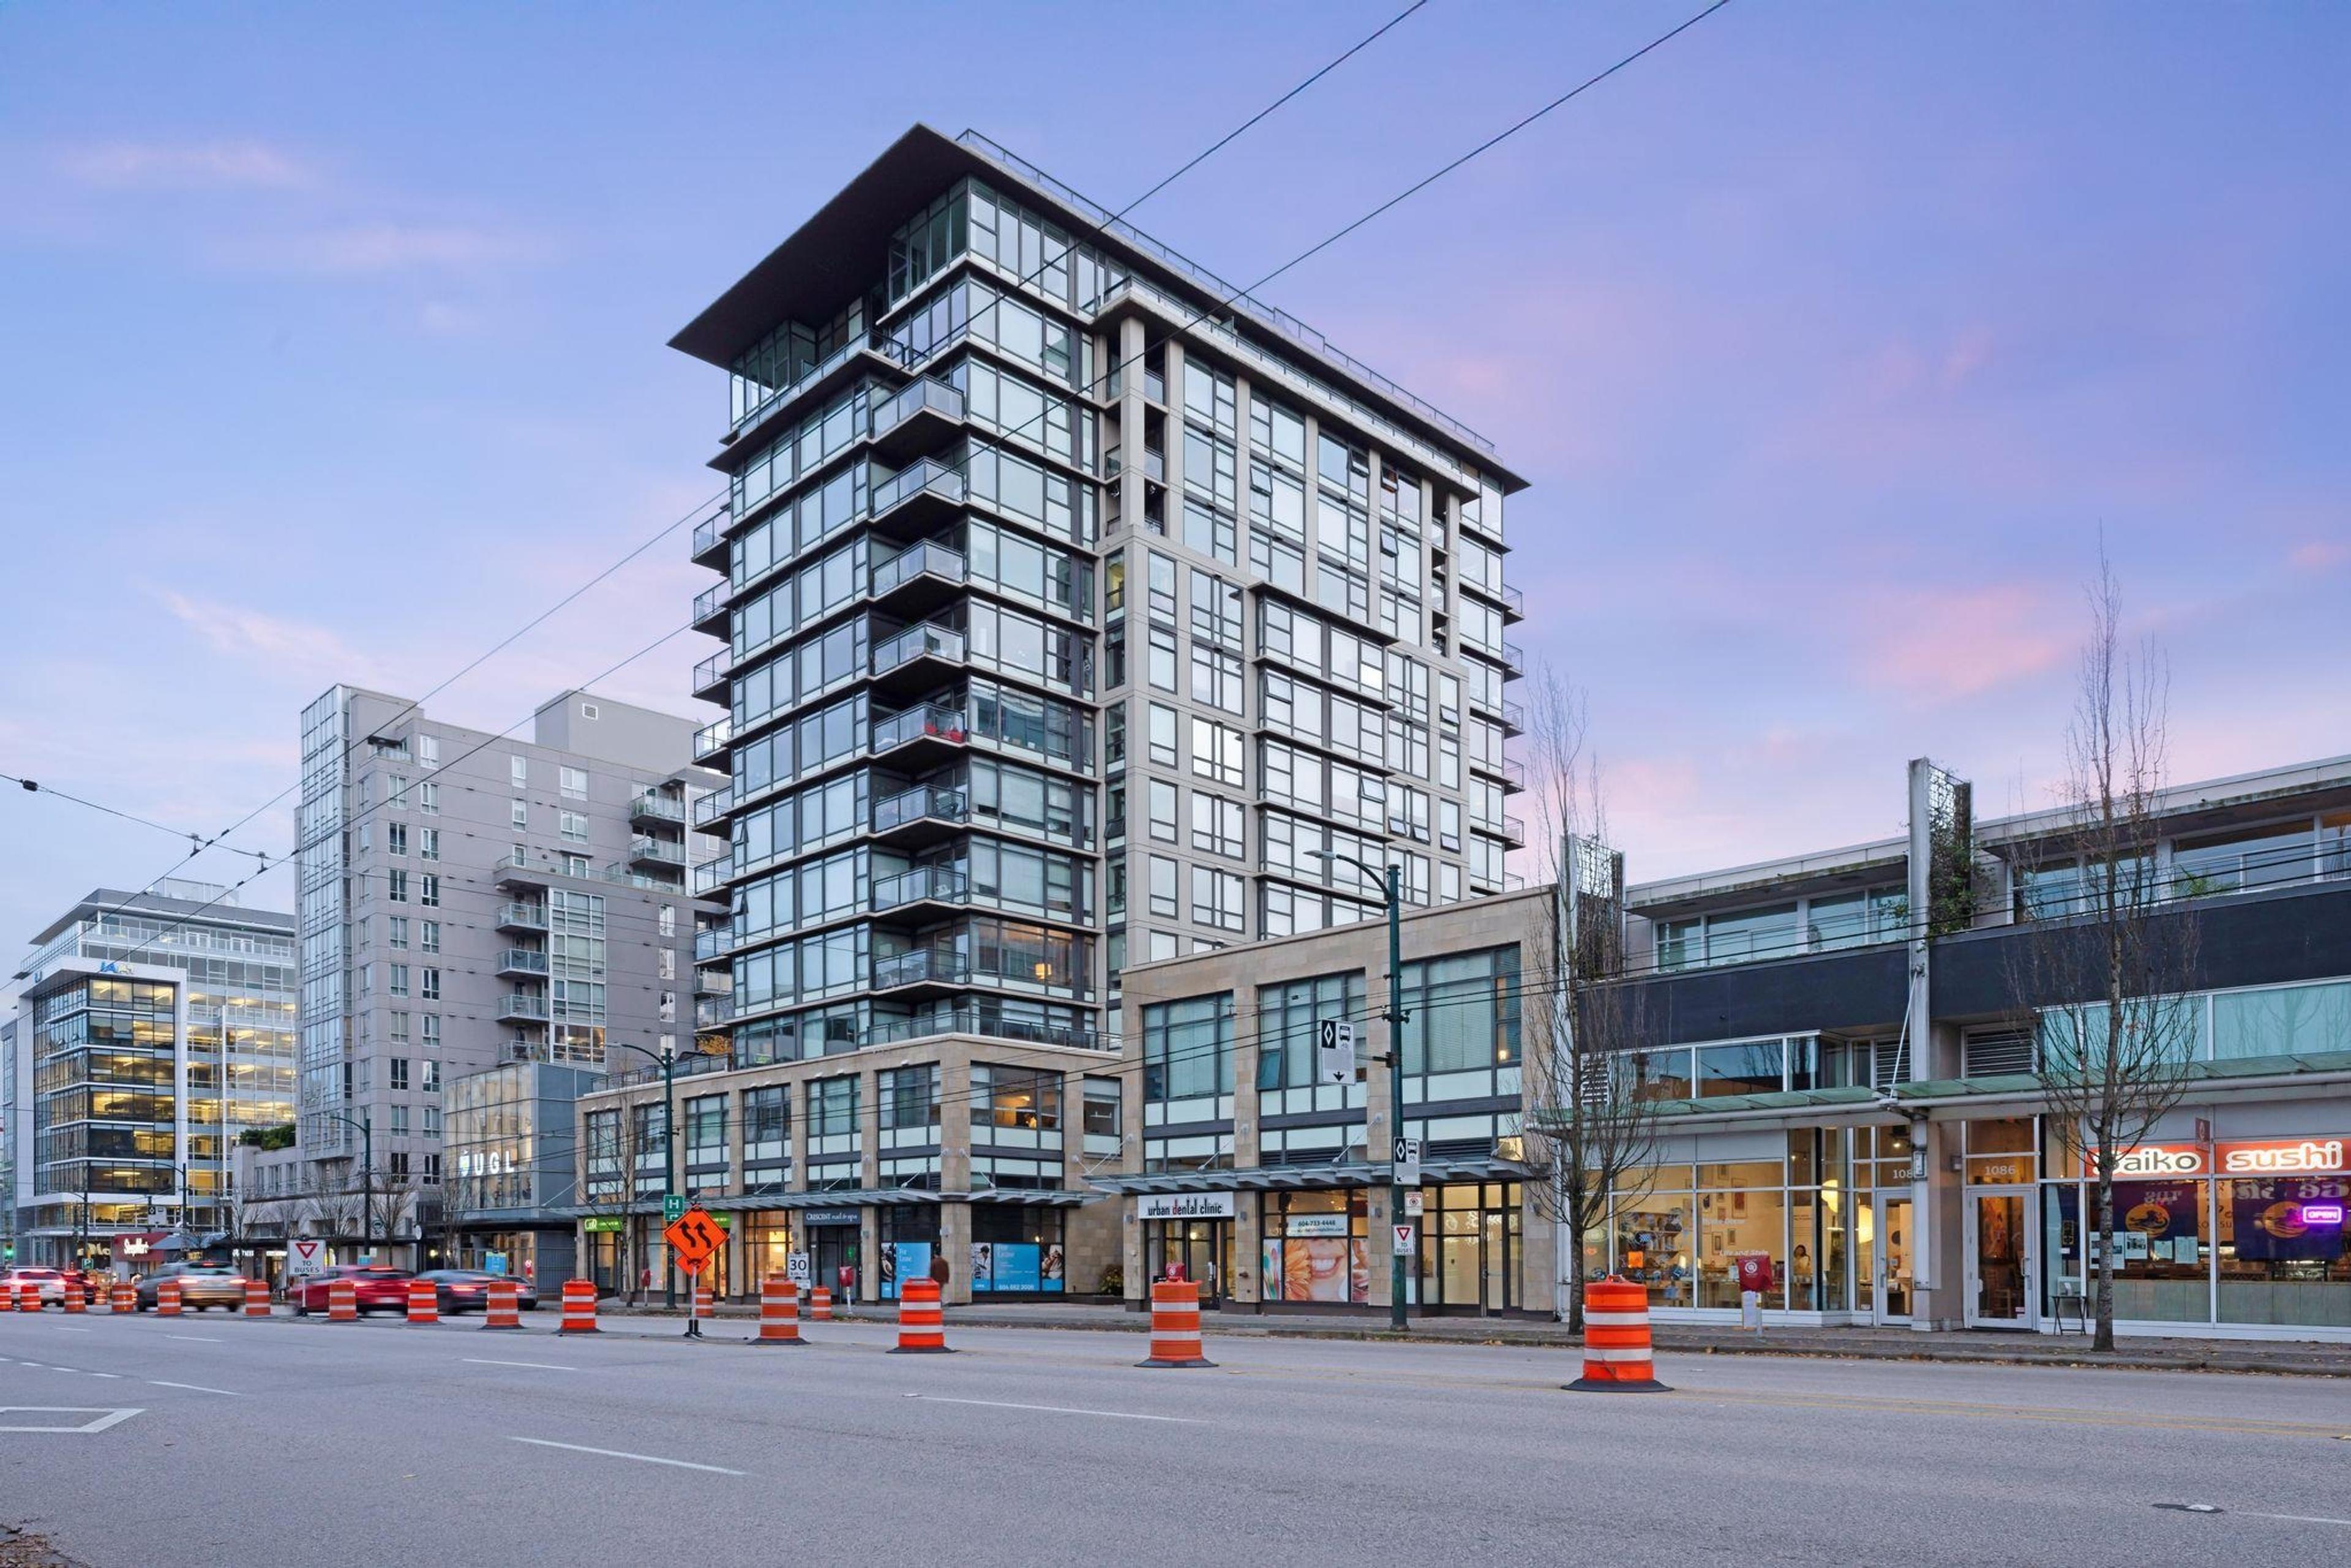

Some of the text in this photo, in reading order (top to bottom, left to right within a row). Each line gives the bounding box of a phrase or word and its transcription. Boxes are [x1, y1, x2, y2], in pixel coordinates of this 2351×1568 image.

[2094, 1143, 2341, 1173] aiko sushi
[1892, 1169, 1914, 1179] 108
[1985, 1165, 2016, 1175] 1086
[669, 1199, 679, 1209] H
[1148, 1197, 1222, 1216] urban dental clinic
[790, 1259, 806, 1270] 30
